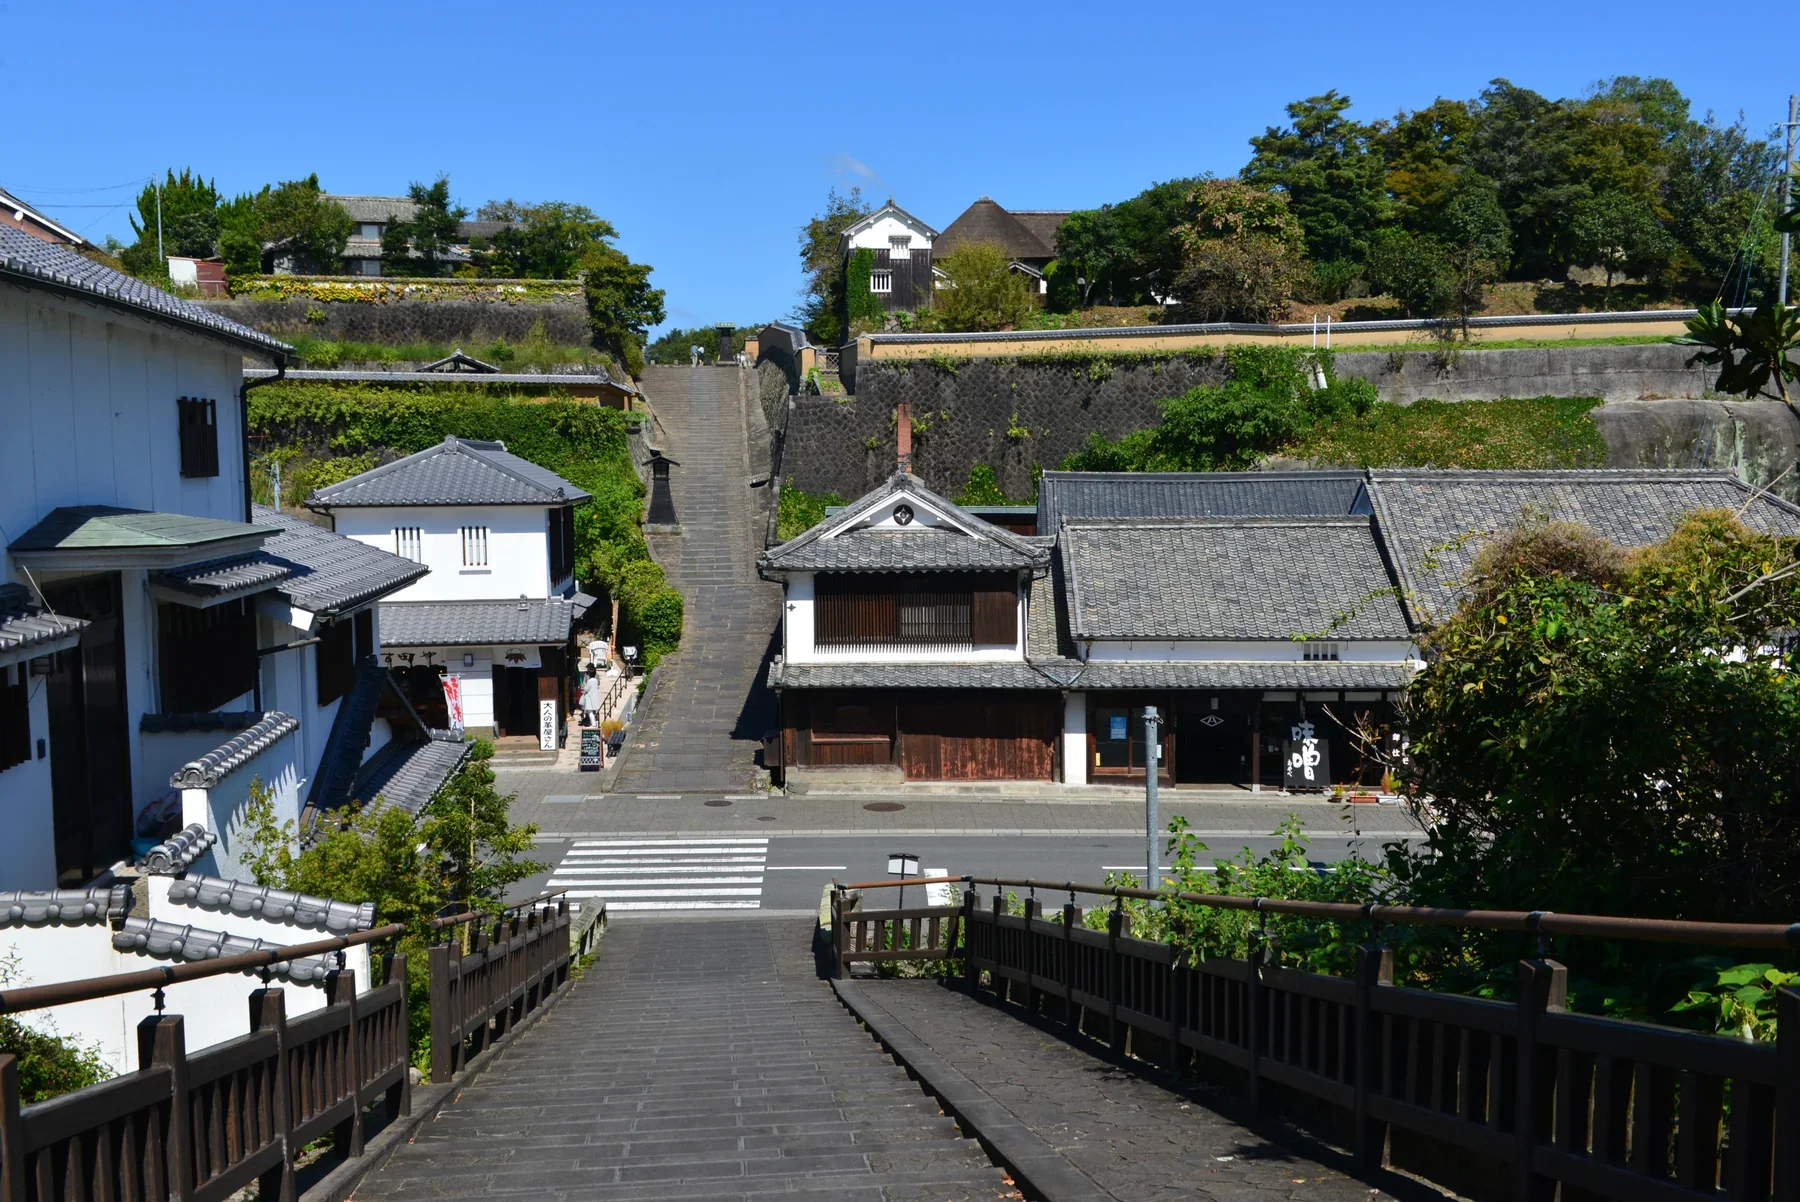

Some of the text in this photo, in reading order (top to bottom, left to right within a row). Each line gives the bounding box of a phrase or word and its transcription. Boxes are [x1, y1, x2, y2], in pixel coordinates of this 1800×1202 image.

[543, 702, 552, 749] 大人の革屋さん
[1291, 720, 1321, 781] 味噌
